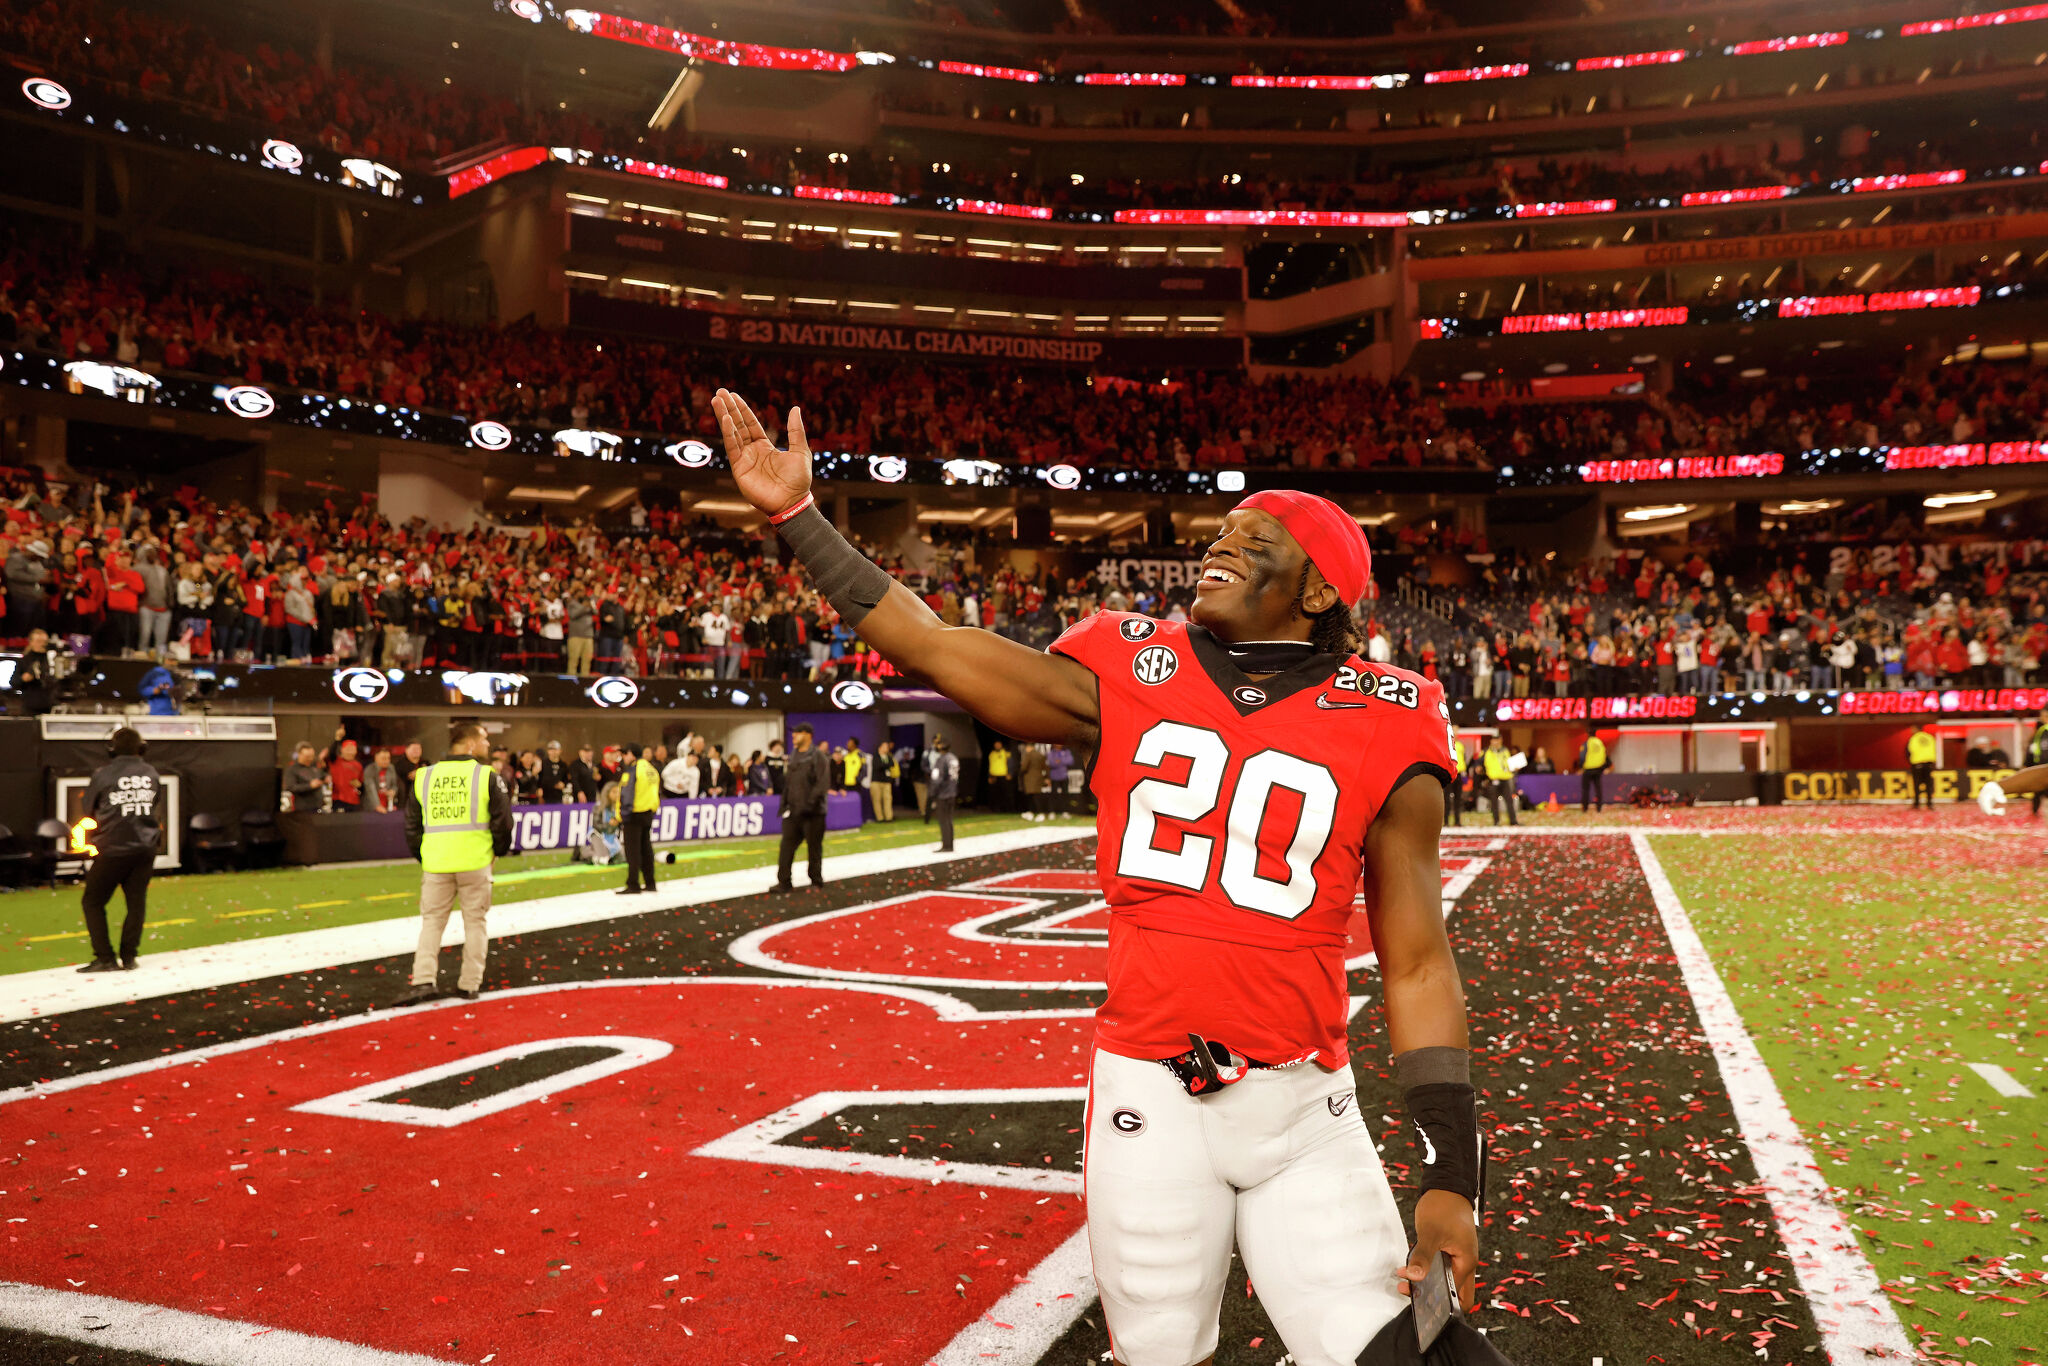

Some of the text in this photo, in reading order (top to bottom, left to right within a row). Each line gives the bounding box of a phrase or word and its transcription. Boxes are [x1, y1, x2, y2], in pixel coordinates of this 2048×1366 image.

[1644, 240, 1748, 265] COLLEGE
[1758, 228, 1885, 258] FOOTBALL
[1502, 306, 1689, 334] NATIONAL CHAMPIONS
[709, 316, 1103, 363] 223 NATIONAL CHAMPIONSHIP
[1583, 453, 1785, 482] GEORGIA BULLDOGS
[1886, 440, 2048, 470] GEORGIA BULL
[1136, 647, 1174, 683] SEC
[1332, 664, 1419, 710] 2023
[1497, 696, 1696, 720] GEORGIA BULLDOGS
[1839, 690, 1939, 714] GEORGIA
[118, 775, 152, 790] CSC
[433, 776, 467, 789] APEX
[121, 802, 153, 817] FIT
[431, 790, 468, 804] SECURITY
[431, 806, 466, 819] GROUP
[510, 810, 561, 850] TCU
[684, 801, 764, 840] FROGS
[1115, 718, 1342, 923] 20
